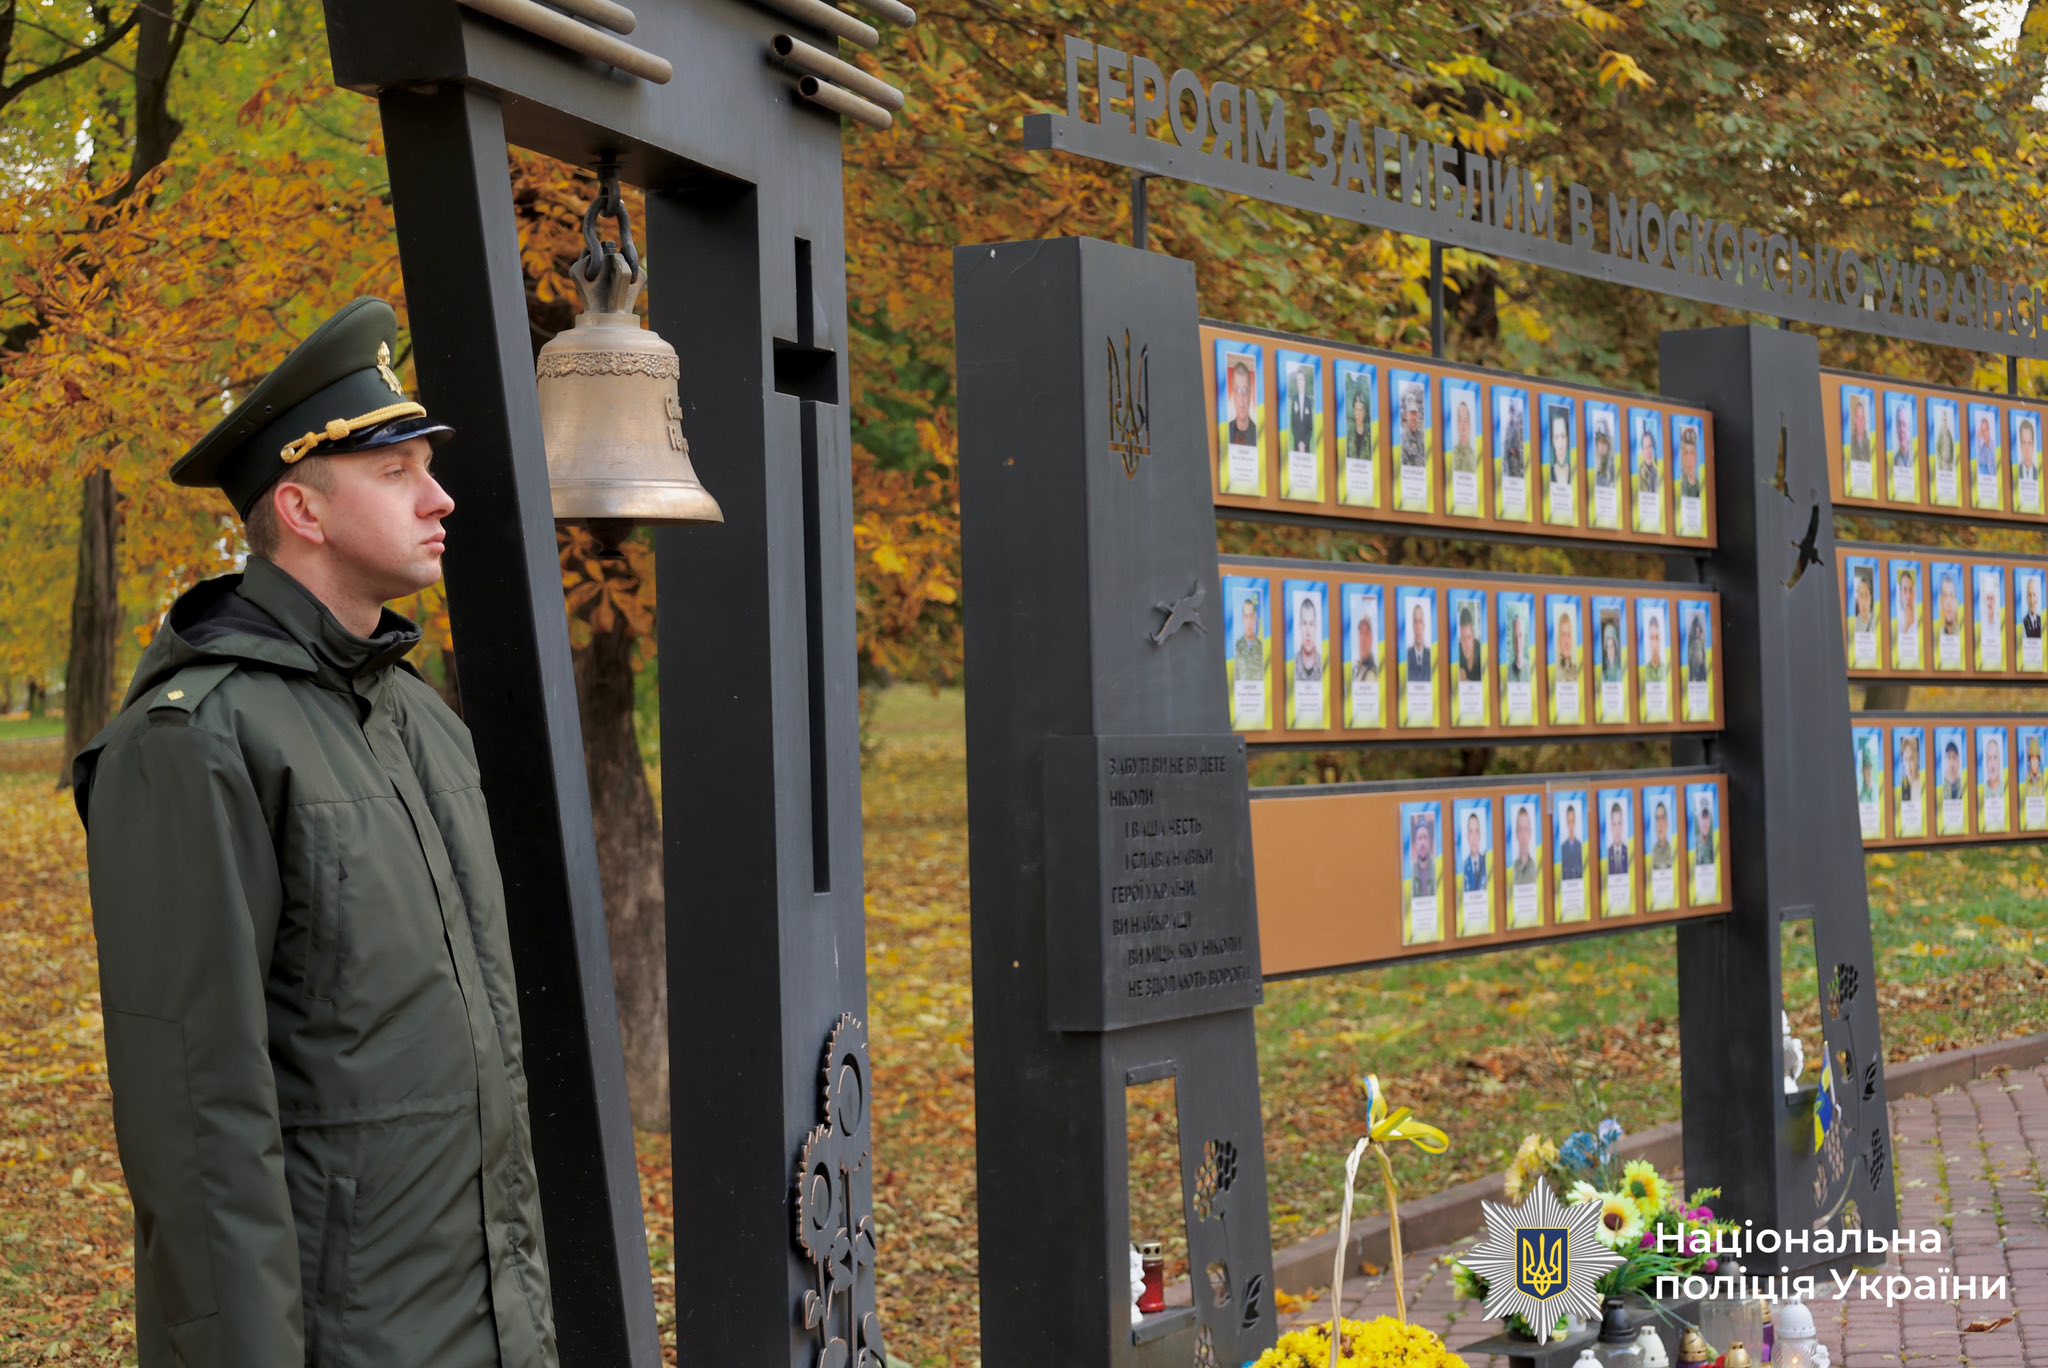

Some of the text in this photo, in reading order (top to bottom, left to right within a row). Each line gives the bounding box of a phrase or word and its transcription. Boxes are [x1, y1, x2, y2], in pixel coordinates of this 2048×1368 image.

[1064, 34, 1287, 174] ГЕРОЯМ
[1308, 107, 1555, 243] ЗАГИБЛИМ
[1569, 182, 1596, 252] В
[1152, 756, 1168, 774] ВИ
[1170, 757, 1185, 774] НЕ
[1187, 756, 1226, 776] БУДЕТЕ
[1110, 788, 1154, 808] НІКОЛИ
[1131, 820, 1167, 838] ВАША
[1168, 817, 1202, 836] ЧЕСТЬ
[1131, 850, 1170, 870] СЛАВА
[1172, 847, 1214, 867] НАВІКИ
[1112, 879, 1144, 904] ГЕРОЇ
[1112, 910, 1192, 936] ВИ НАЙКРАЩІ
[1128, 948, 1144, 966] ВИ
[1178, 941, 1199, 960] ЯКУ
[1202, 936, 1243, 957] НІКОЛИ
[1128, 979, 1143, 998] НЕ
[1145, 971, 1207, 997] ЗДОЛАЮТЬ
